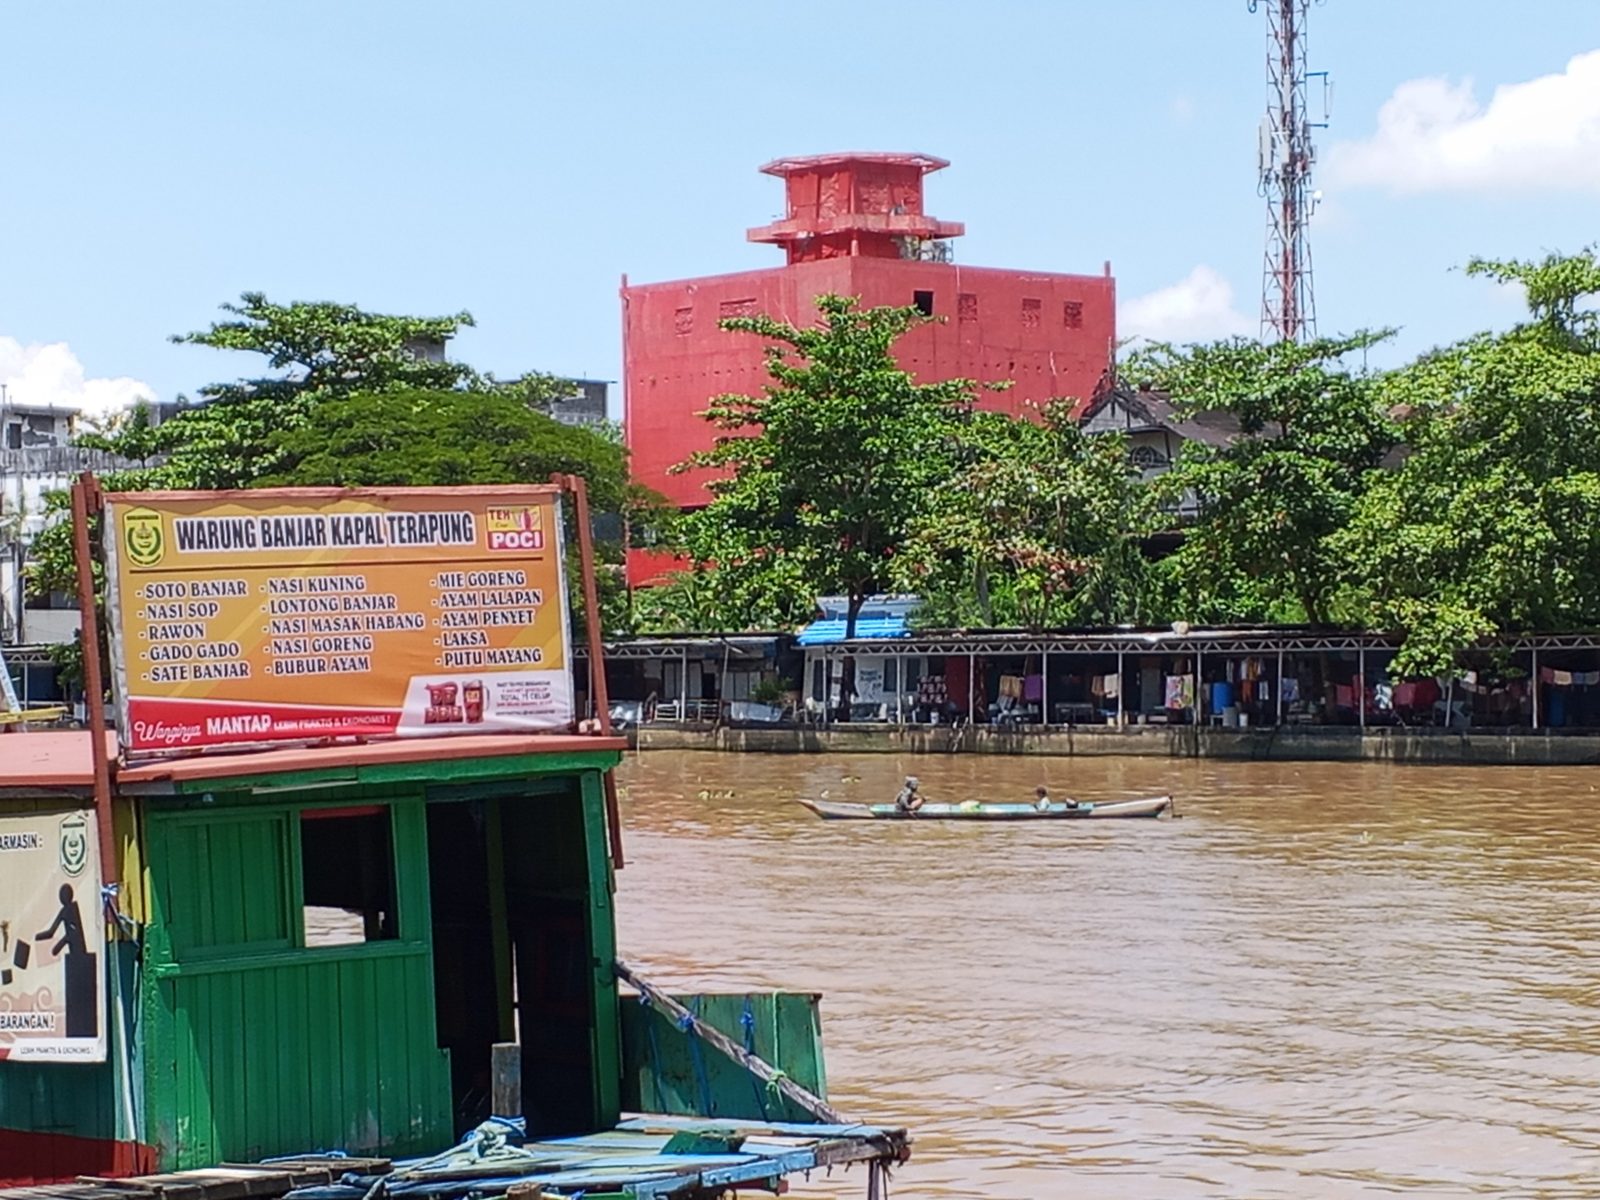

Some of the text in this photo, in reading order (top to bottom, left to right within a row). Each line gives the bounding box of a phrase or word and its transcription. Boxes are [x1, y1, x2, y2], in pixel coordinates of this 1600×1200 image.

[489, 509, 510, 520] TEH
[176, 513, 474, 550] WARUNG BANJAR KAPAL TERAPUNG
[492, 531, 540, 548] POCI
[269, 576, 365, 593] NASI KUNING
[439, 571, 525, 587] MIE GORENG
[146, 581, 246, 598] SOTO BANJAR
[270, 595, 396, 614] LONTONG BANJAR
[440, 590, 541, 607] AYAM LALAPAN
[147, 602, 218, 619] NASI SOP
[442, 610, 534, 626] AYAM PENYET
[149, 624, 204, 640] RAWON
[272, 614, 424, 633] NASI MASAK HABANG
[273, 636, 372, 654] NASI GORENG
[443, 632, 487, 646] LAKSA
[150, 642, 239, 660] GADO GADO
[445, 648, 541, 666] PUTU MAYANG
[151, 662, 249, 681] SATE BANJAR
[275, 656, 369, 674] BUBUR AYAM
[206, 715, 271, 735] MANTAP
